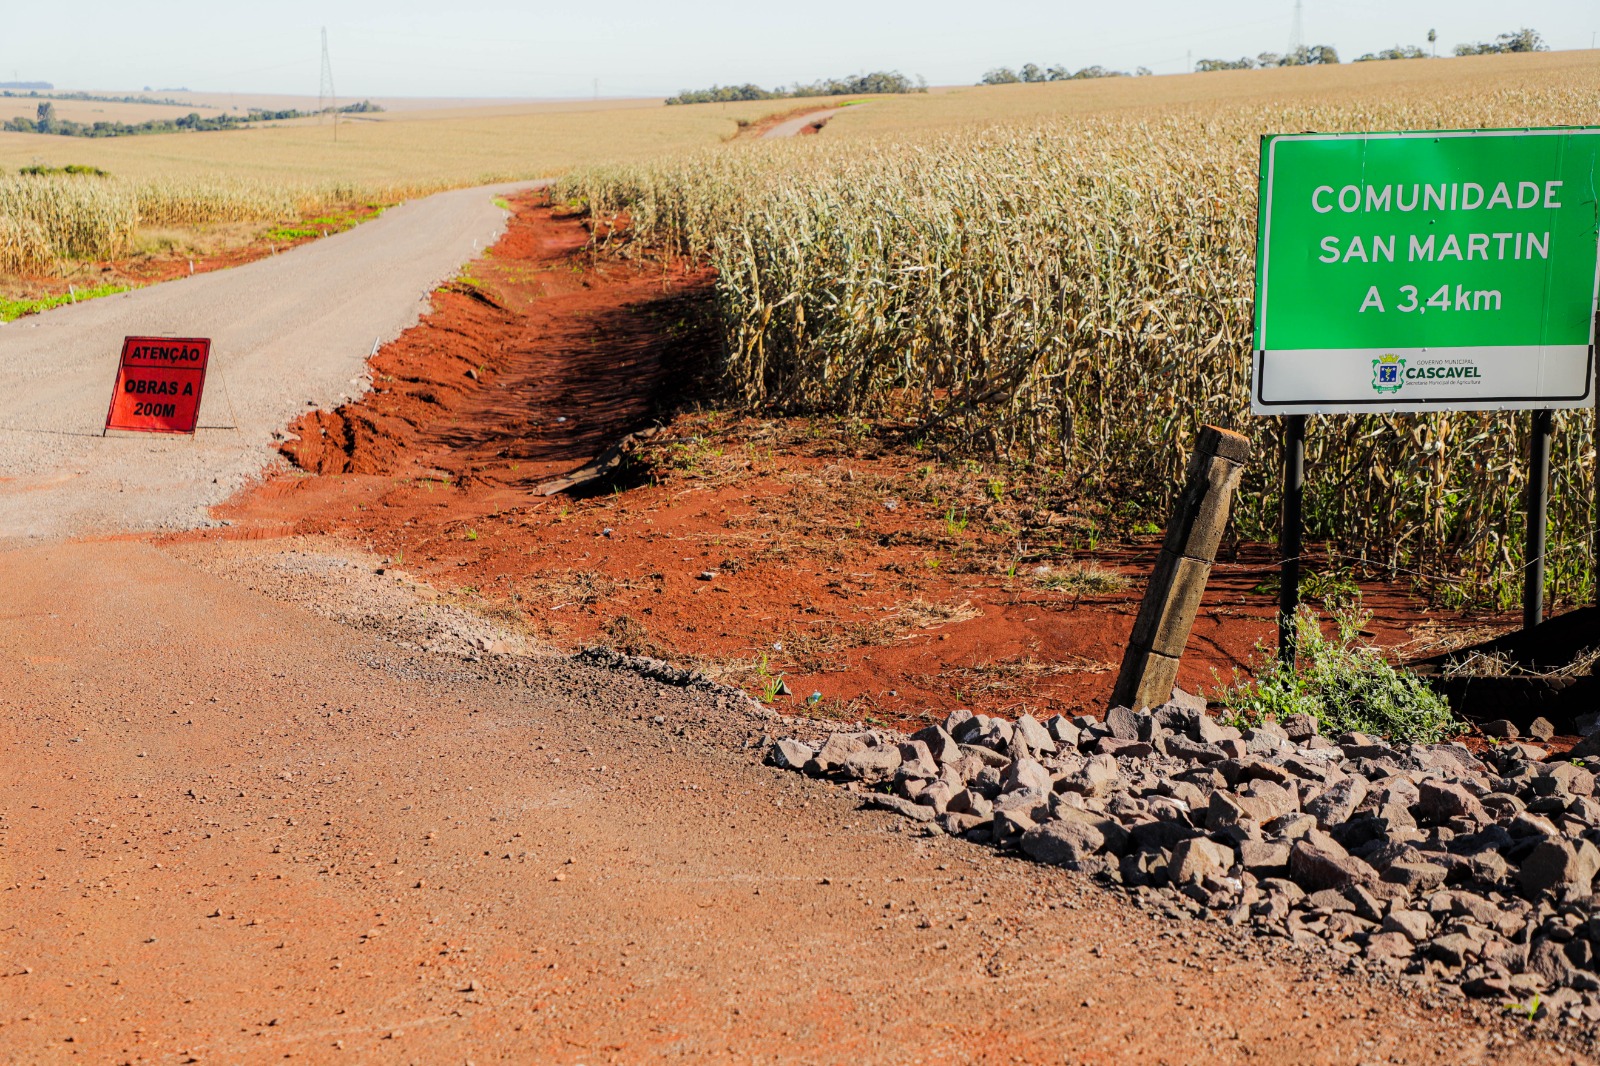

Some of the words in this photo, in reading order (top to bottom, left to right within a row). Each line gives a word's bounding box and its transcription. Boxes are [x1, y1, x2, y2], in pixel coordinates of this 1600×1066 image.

[1312, 180, 1564, 213] COMUNIDADE
[1318, 235, 1395, 263] SAN
[1408, 232, 1550, 261] MARTIN
[1359, 286, 1385, 313] A
[1396, 284, 1502, 315] 3,4km
[131, 345, 200, 364] ATENÇÃO
[1405, 366, 1482, 379] CASCAVEL
[124, 379, 179, 395] OBRAS
[182, 382, 193, 396] A
[133, 402, 176, 418] 200M
